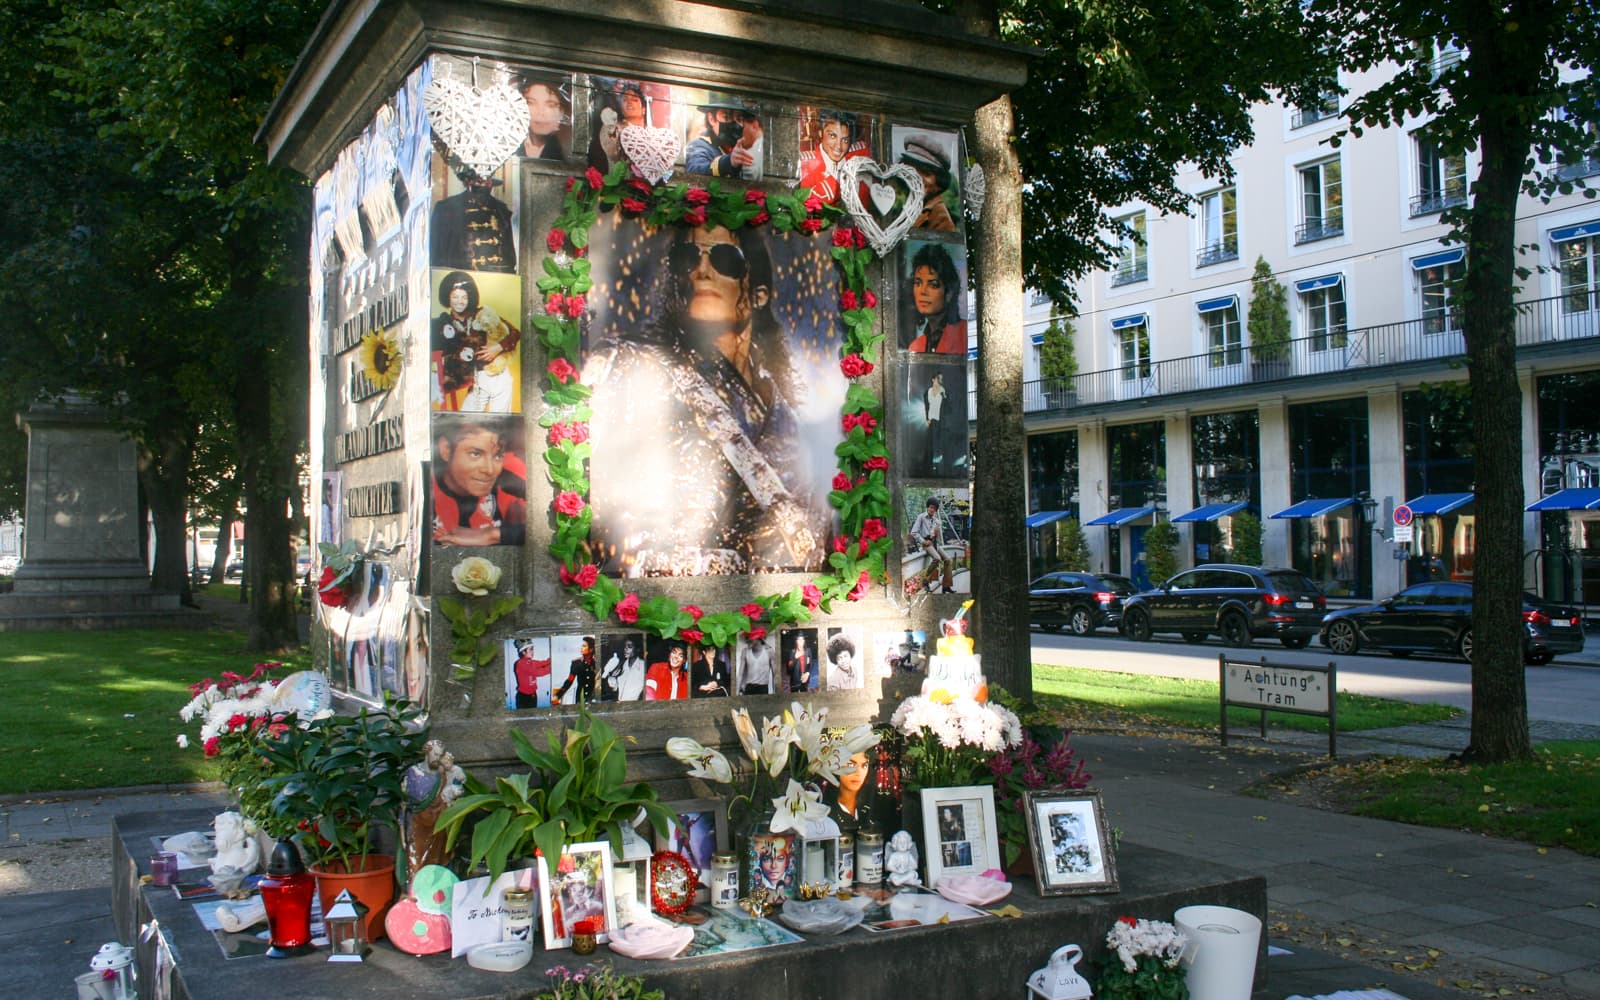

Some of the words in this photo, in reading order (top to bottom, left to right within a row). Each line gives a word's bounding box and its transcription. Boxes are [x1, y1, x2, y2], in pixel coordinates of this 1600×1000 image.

[335, 426, 368, 464] ORLANDO
[368, 423, 376, 456] DI
[1244, 669, 1308, 692] Achtung
[1257, 688, 1296, 706] Tram
